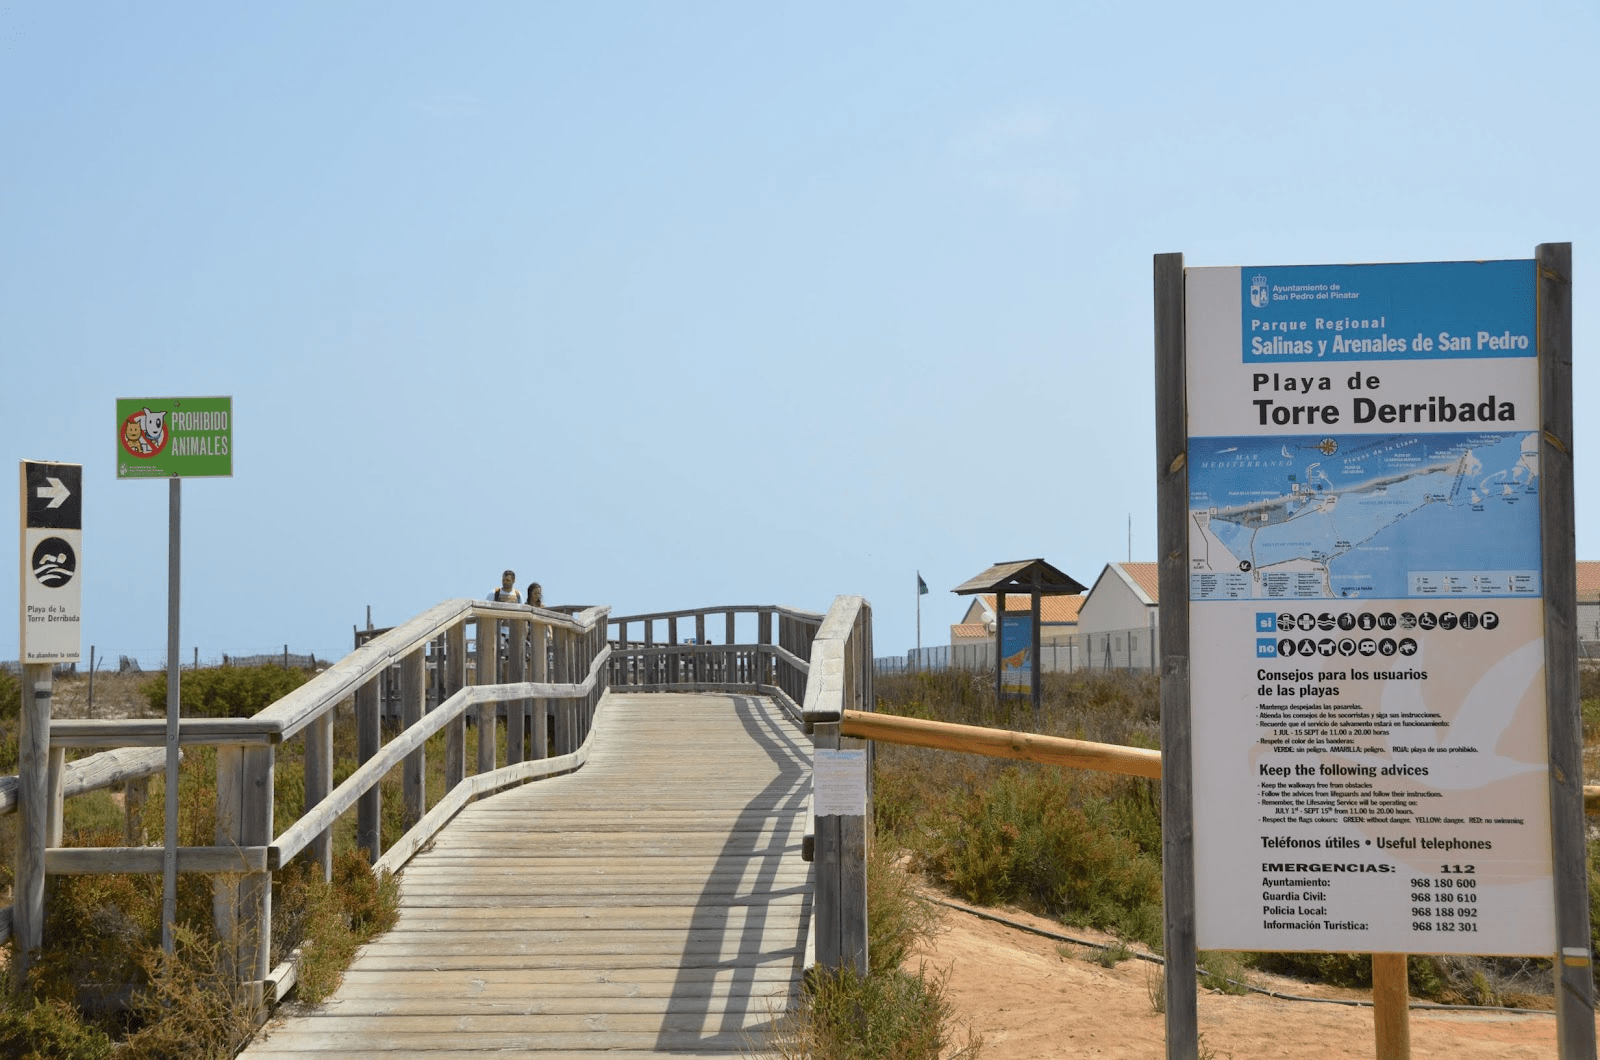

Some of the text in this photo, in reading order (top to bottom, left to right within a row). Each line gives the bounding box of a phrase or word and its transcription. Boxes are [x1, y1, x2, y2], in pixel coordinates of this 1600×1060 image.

[1273, 284, 1327, 293] Ayuntamiento
[1330, 291, 1360, 299] Pinatar
[1252, 316, 1385, 332] Parque Regional
[1251, 331, 1529, 358] Salinas y Arenales de San Pedro
[1253, 371, 1381, 394] Playa de
[1253, 395, 1515, 425] Torre Derribada
[172, 411, 227, 431] PROHIBIDO
[172, 436, 228, 456] ANIMALES
[1483, 614, 1495, 627] P
[1258, 645, 1275, 653] no
[1257, 668, 1428, 683] Consejos para los usuarios
[1258, 684, 1339, 698] de las playas
[1259, 764, 1429, 777] Keep the following advices
[1261, 836, 1492, 851] Teléfonos útiles Useful telephones
[1262, 863, 1475, 874] EMERGENCIAS: 112
[1262, 878, 1476, 889] Ayuntamiento: 968 180 600
[1263, 892, 1477, 903] Guardia Civil: 968 180 610
[1263, 906, 1477, 917] Policia Local: 968 188 092
[1264, 919, 1321, 930] Información
[1412, 922, 1432, 932] 968
[1436, 922, 1454, 932] 182
[1458, 922, 1478, 932] 301
